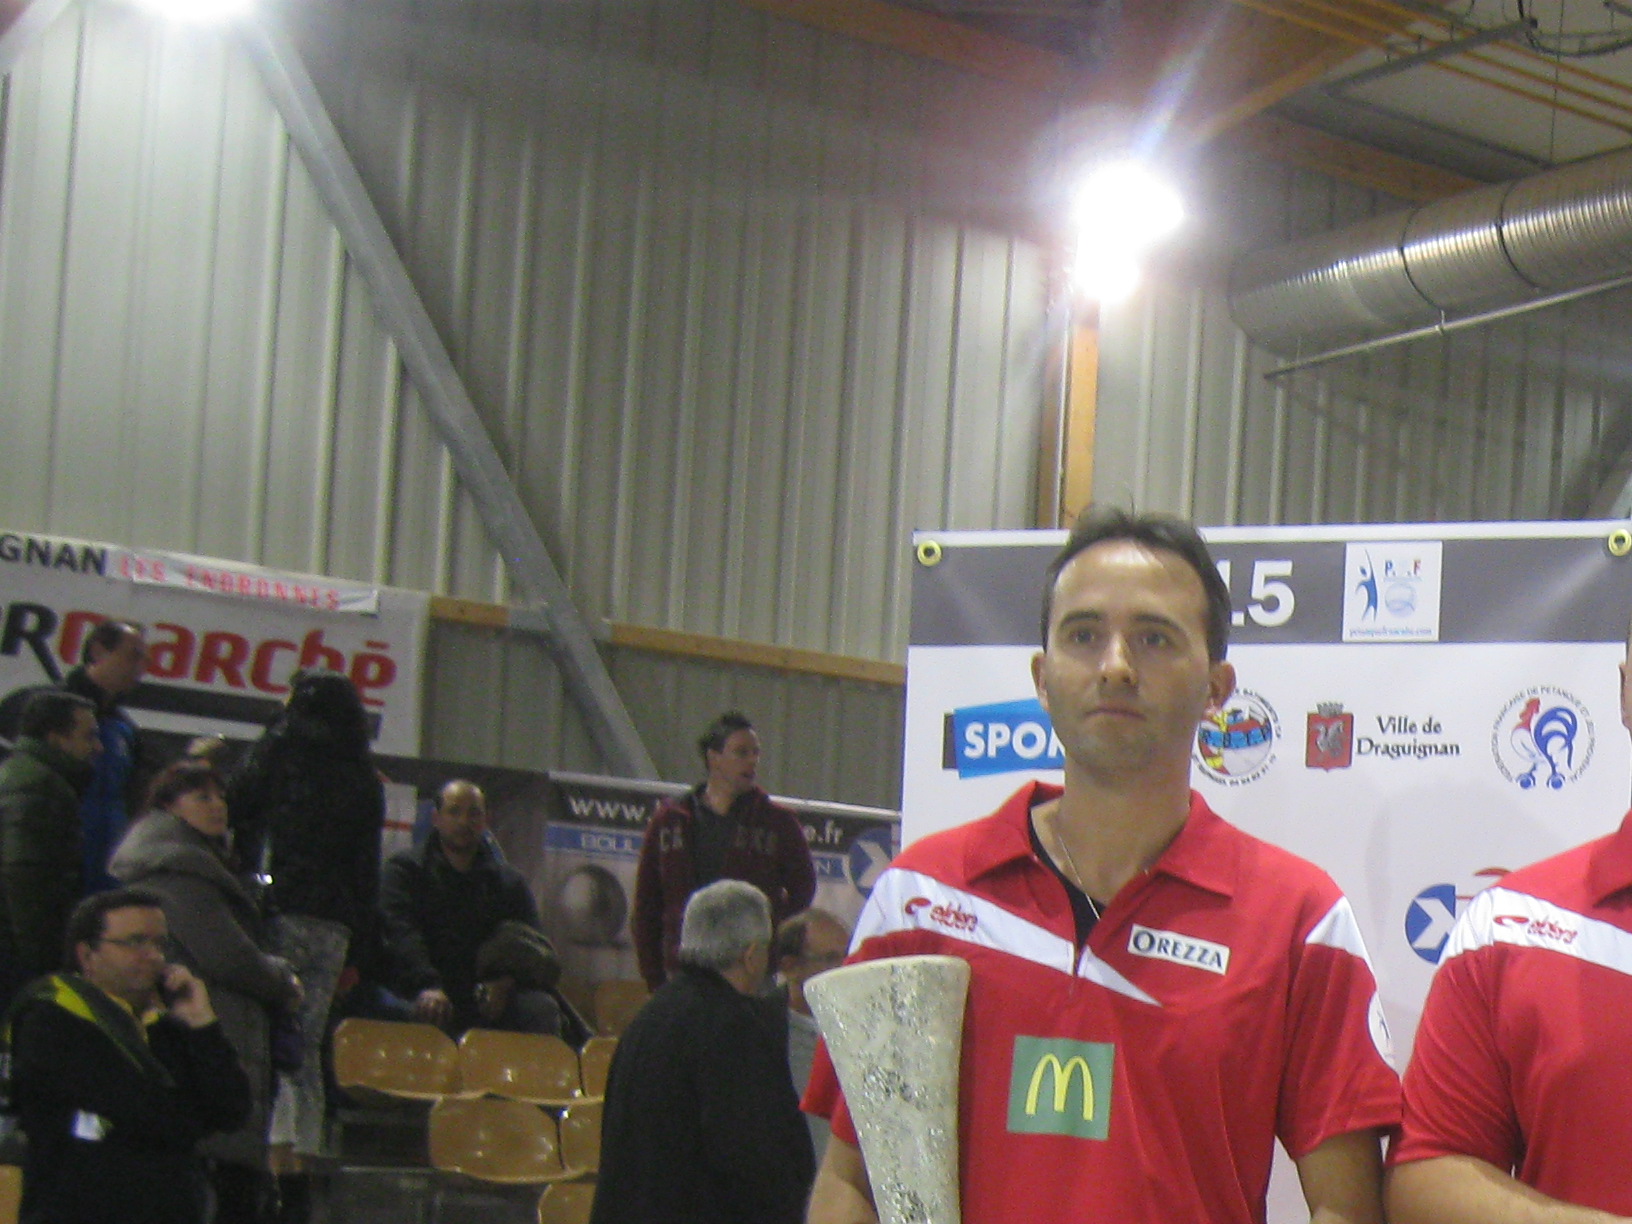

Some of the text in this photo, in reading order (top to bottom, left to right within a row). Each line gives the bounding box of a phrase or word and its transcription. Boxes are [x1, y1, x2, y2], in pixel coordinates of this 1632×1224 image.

[1377, 715, 1442, 735] Ville de
[1357, 737, 1460, 760] Draguignan
[1132, 929, 1224, 970] OREZZA
